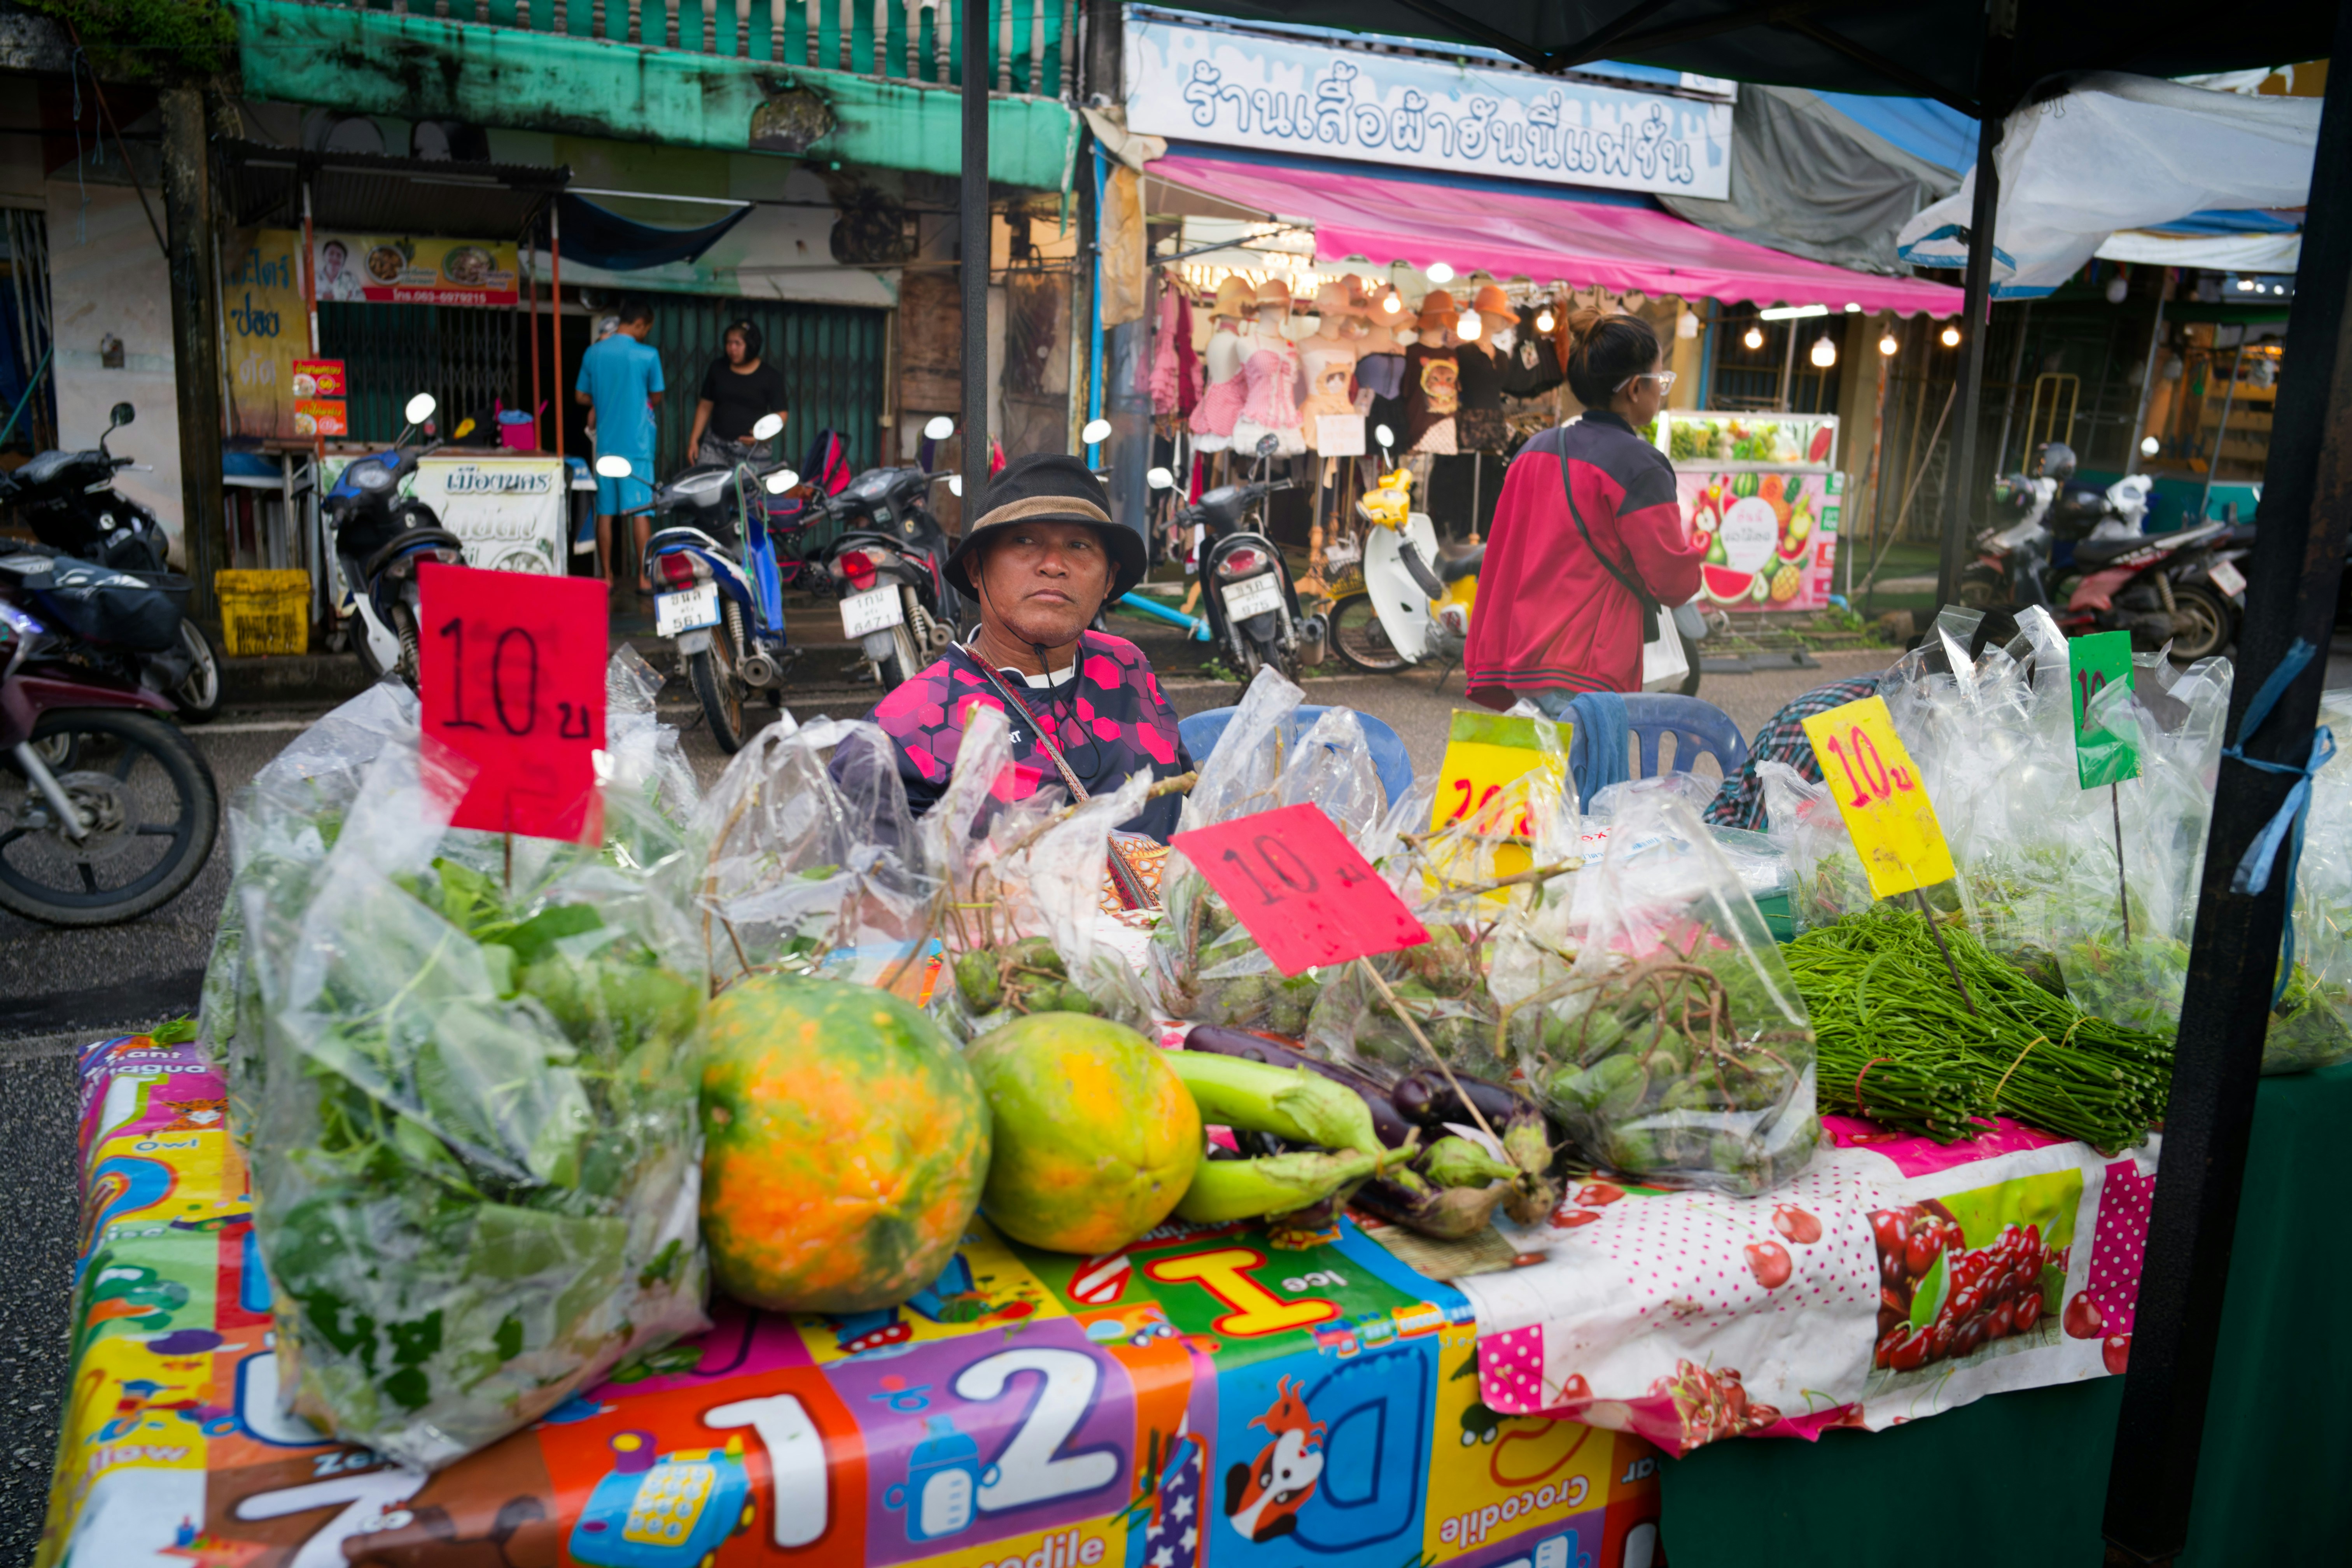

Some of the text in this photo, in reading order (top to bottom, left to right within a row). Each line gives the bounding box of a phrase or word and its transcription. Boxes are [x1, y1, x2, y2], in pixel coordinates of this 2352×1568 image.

[446, 466, 550, 491] เมืองนคร
[136, 1139, 198, 1151] Owl
[1281, 1269, 1348, 1292] Ice
[952, 1346, 1119, 1513] 2
[703, 1393, 828, 1548] 1
[1439, 1475, 1589, 1549] Crocodile
